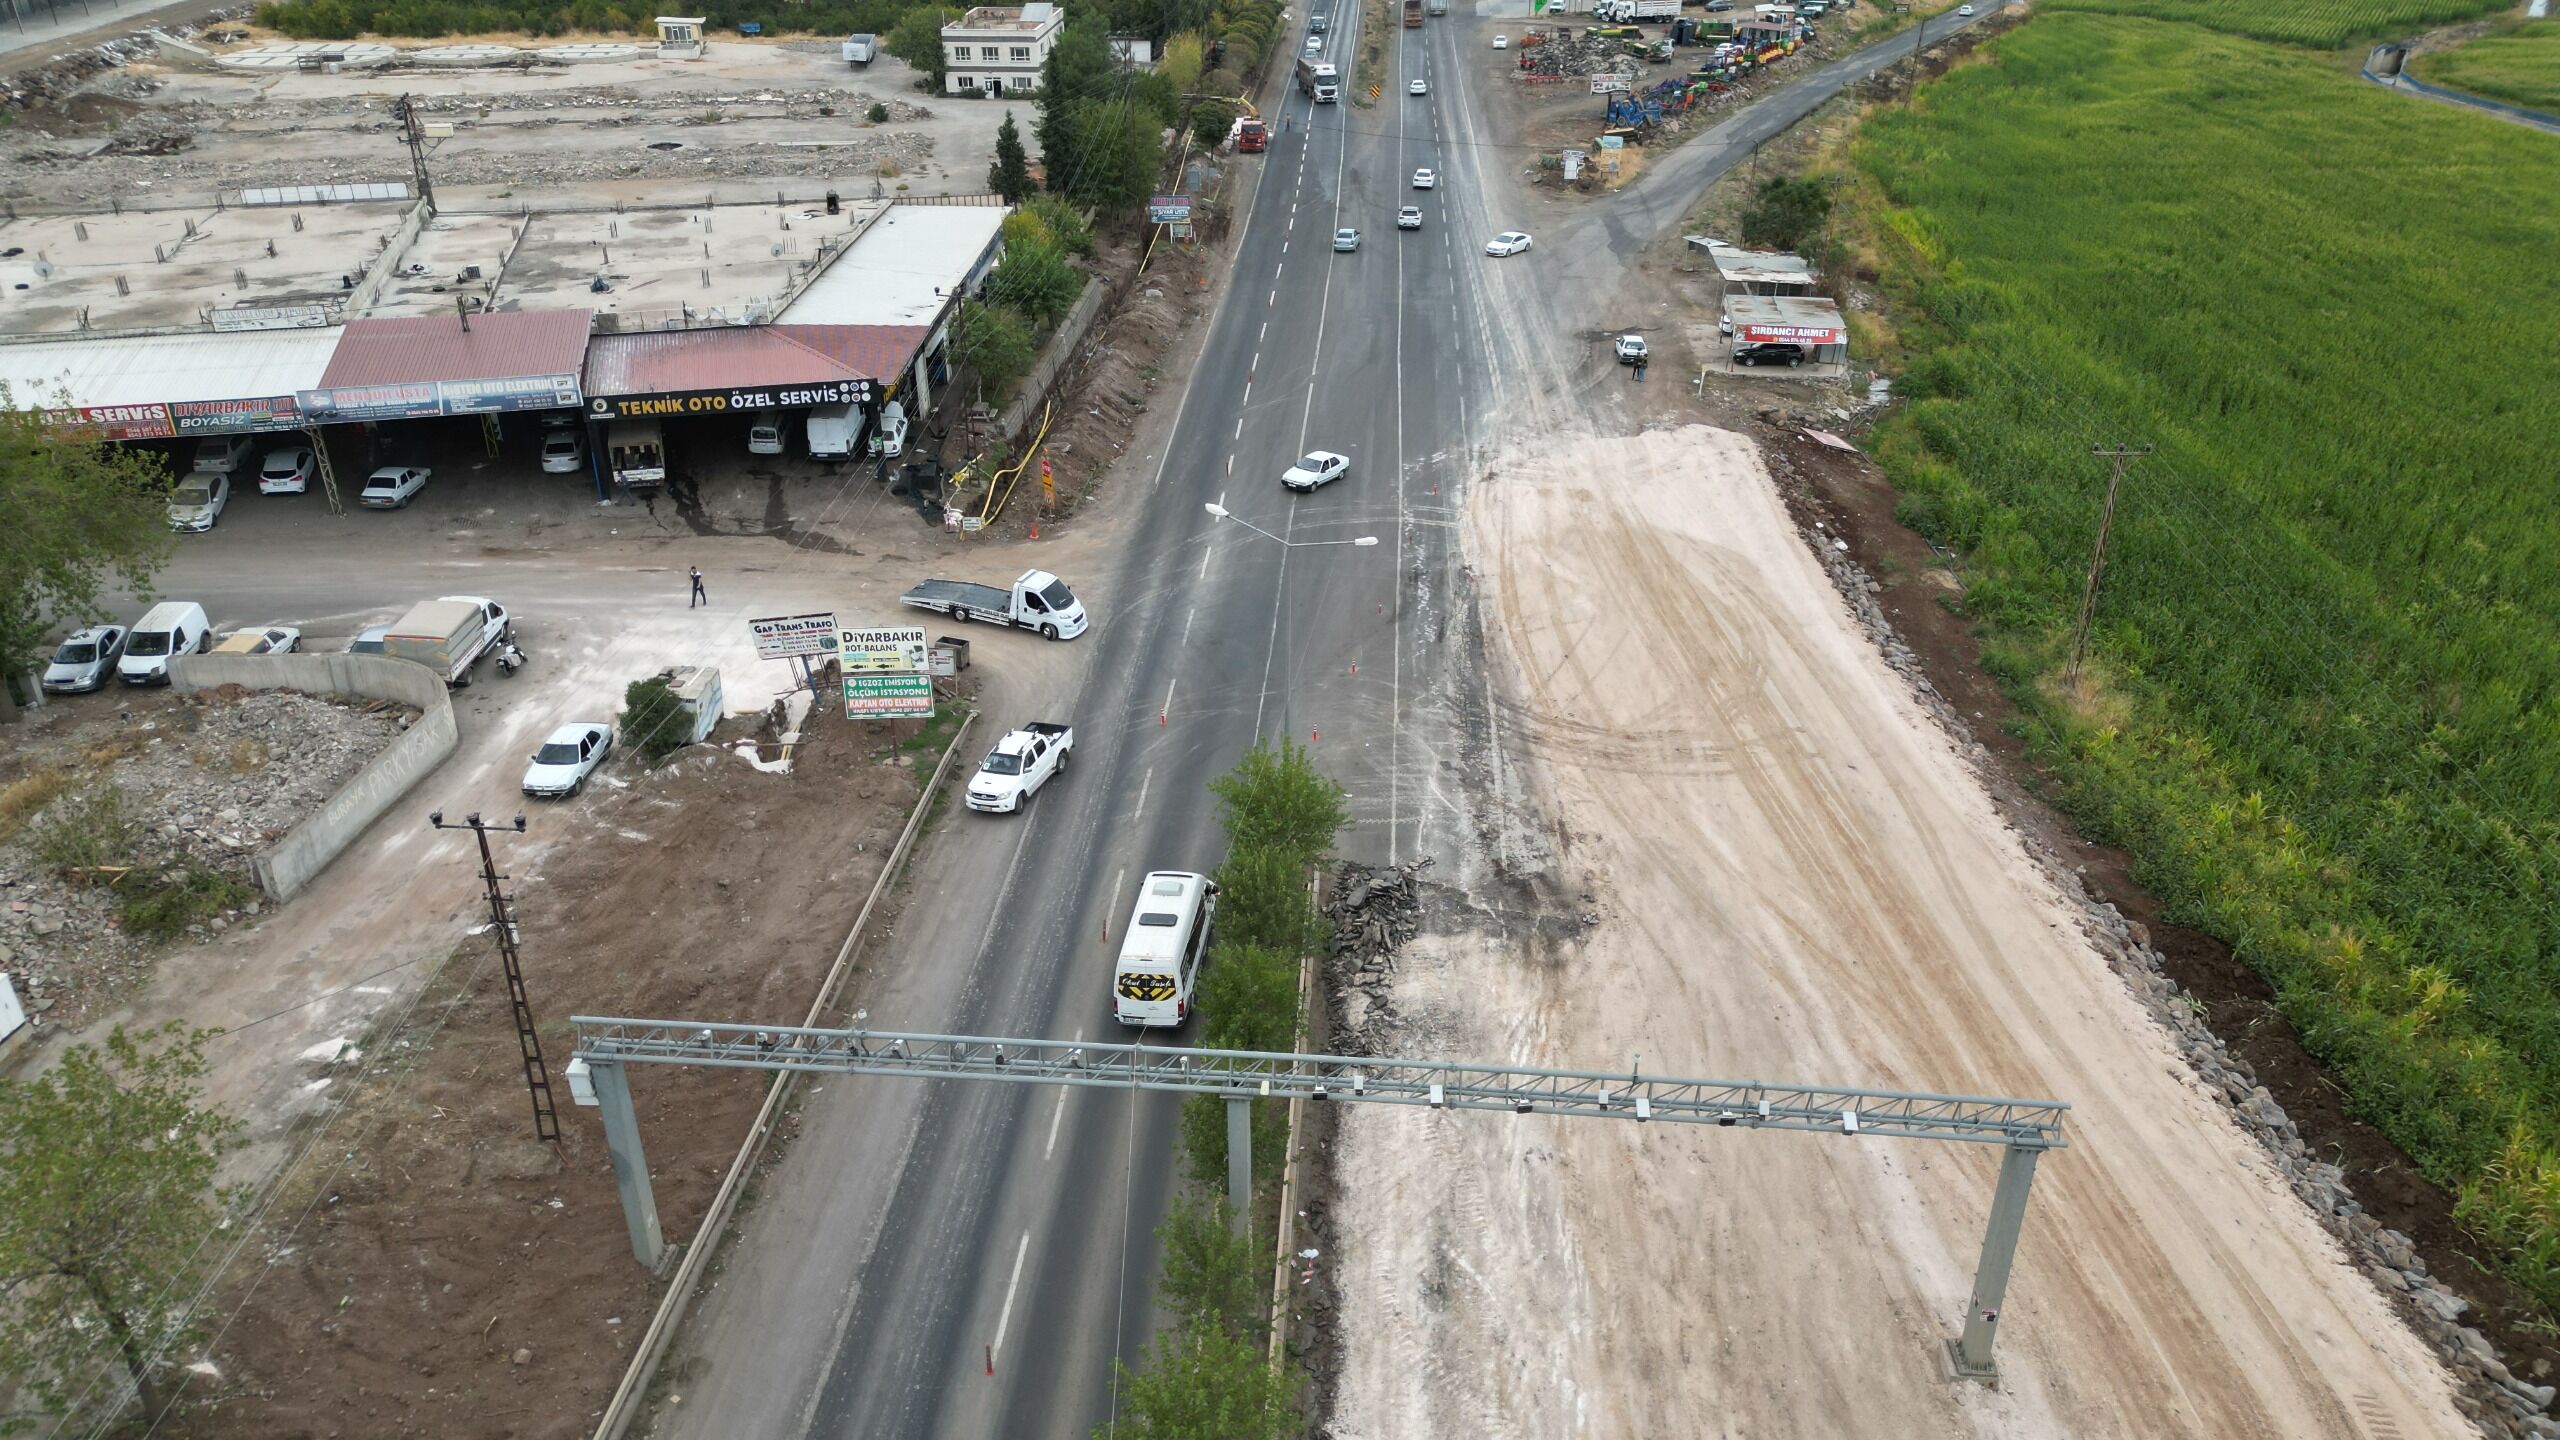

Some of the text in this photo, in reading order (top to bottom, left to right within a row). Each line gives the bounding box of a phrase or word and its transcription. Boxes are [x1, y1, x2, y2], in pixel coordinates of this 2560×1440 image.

[1797, 328, 1830, 337] AHMET
[484, 382, 505, 394] OTO
[618, 384, 839, 416] TEKNİK OTO ÖZEL SERVİS
[180, 415, 245, 428] BOYASIZ
[754, 625, 773, 634] GAP
[845, 644, 897, 652] ROT-BALANS
[849, 698, 877, 709] KAPTAN
[879, 698, 894, 708] OTO
[368, 753, 406, 800] PARK
